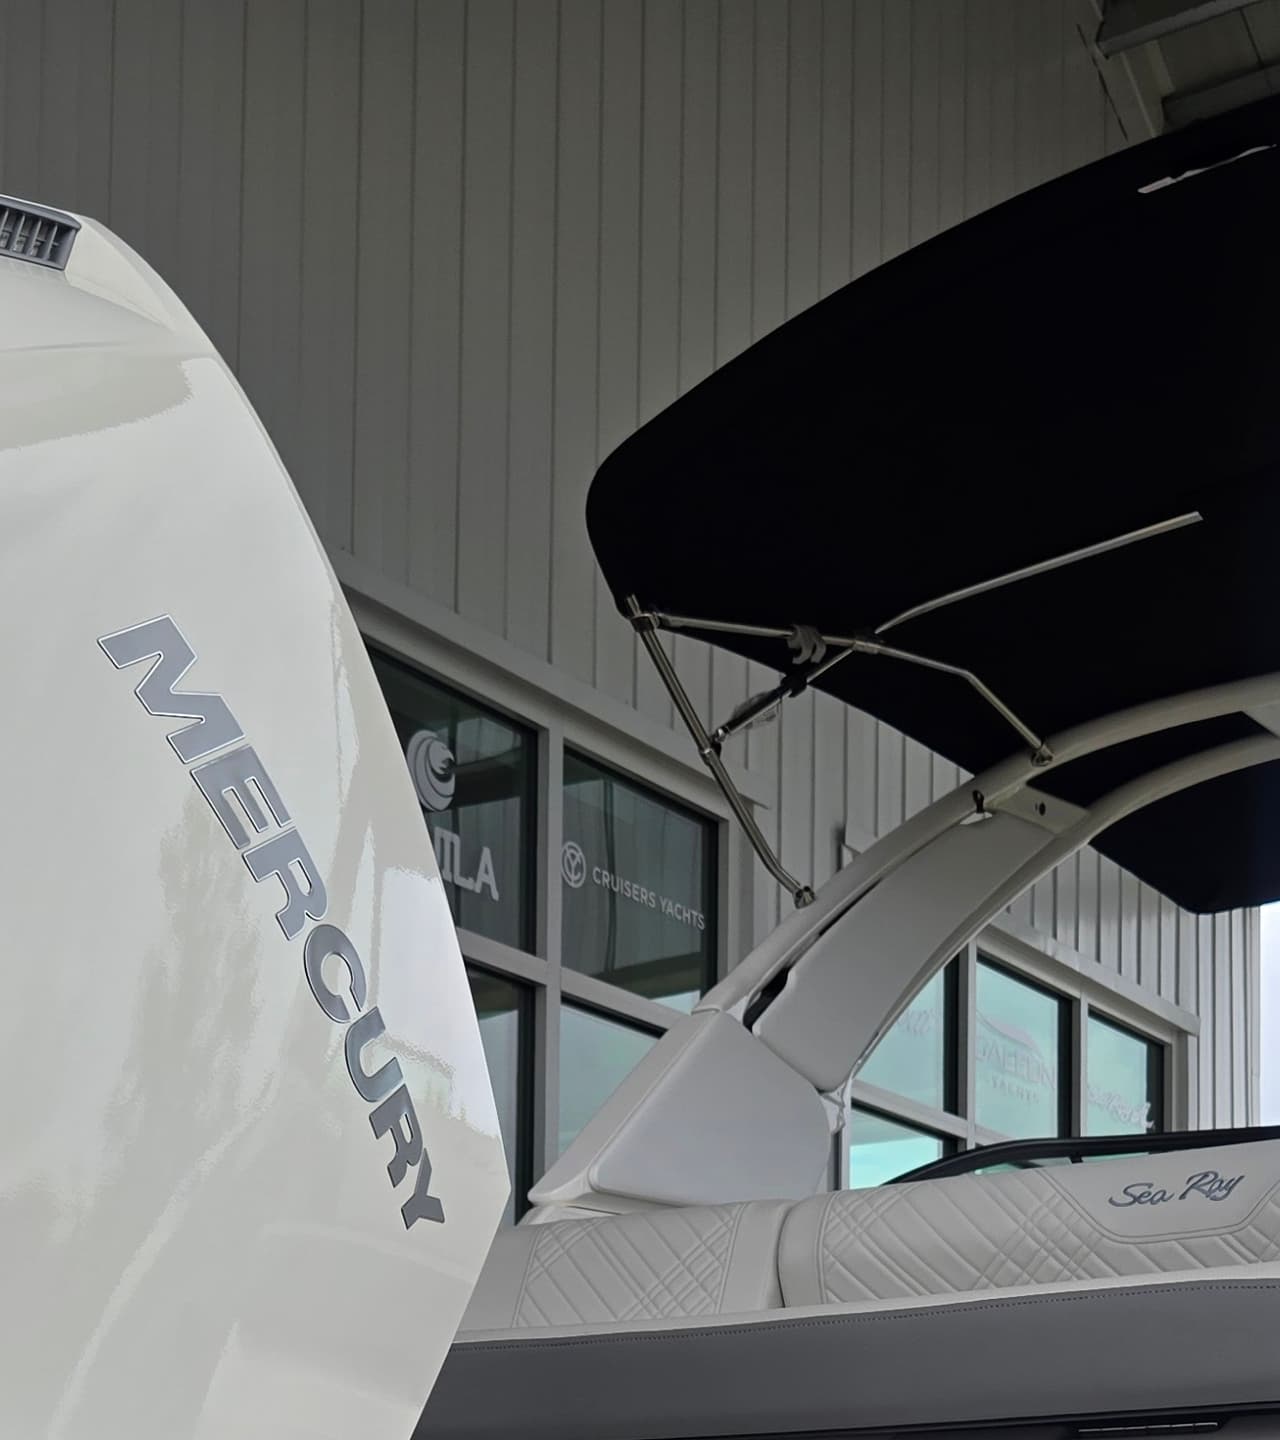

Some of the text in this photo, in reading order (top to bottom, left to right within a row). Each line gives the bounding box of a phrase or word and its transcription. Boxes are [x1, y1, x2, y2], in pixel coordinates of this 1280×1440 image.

[96, 613, 446, 1231] MERCURY
[592, 867, 705, 930] CRUISERS YACHTS
[1108, 1170, 1245, 1207] Sea Ray
